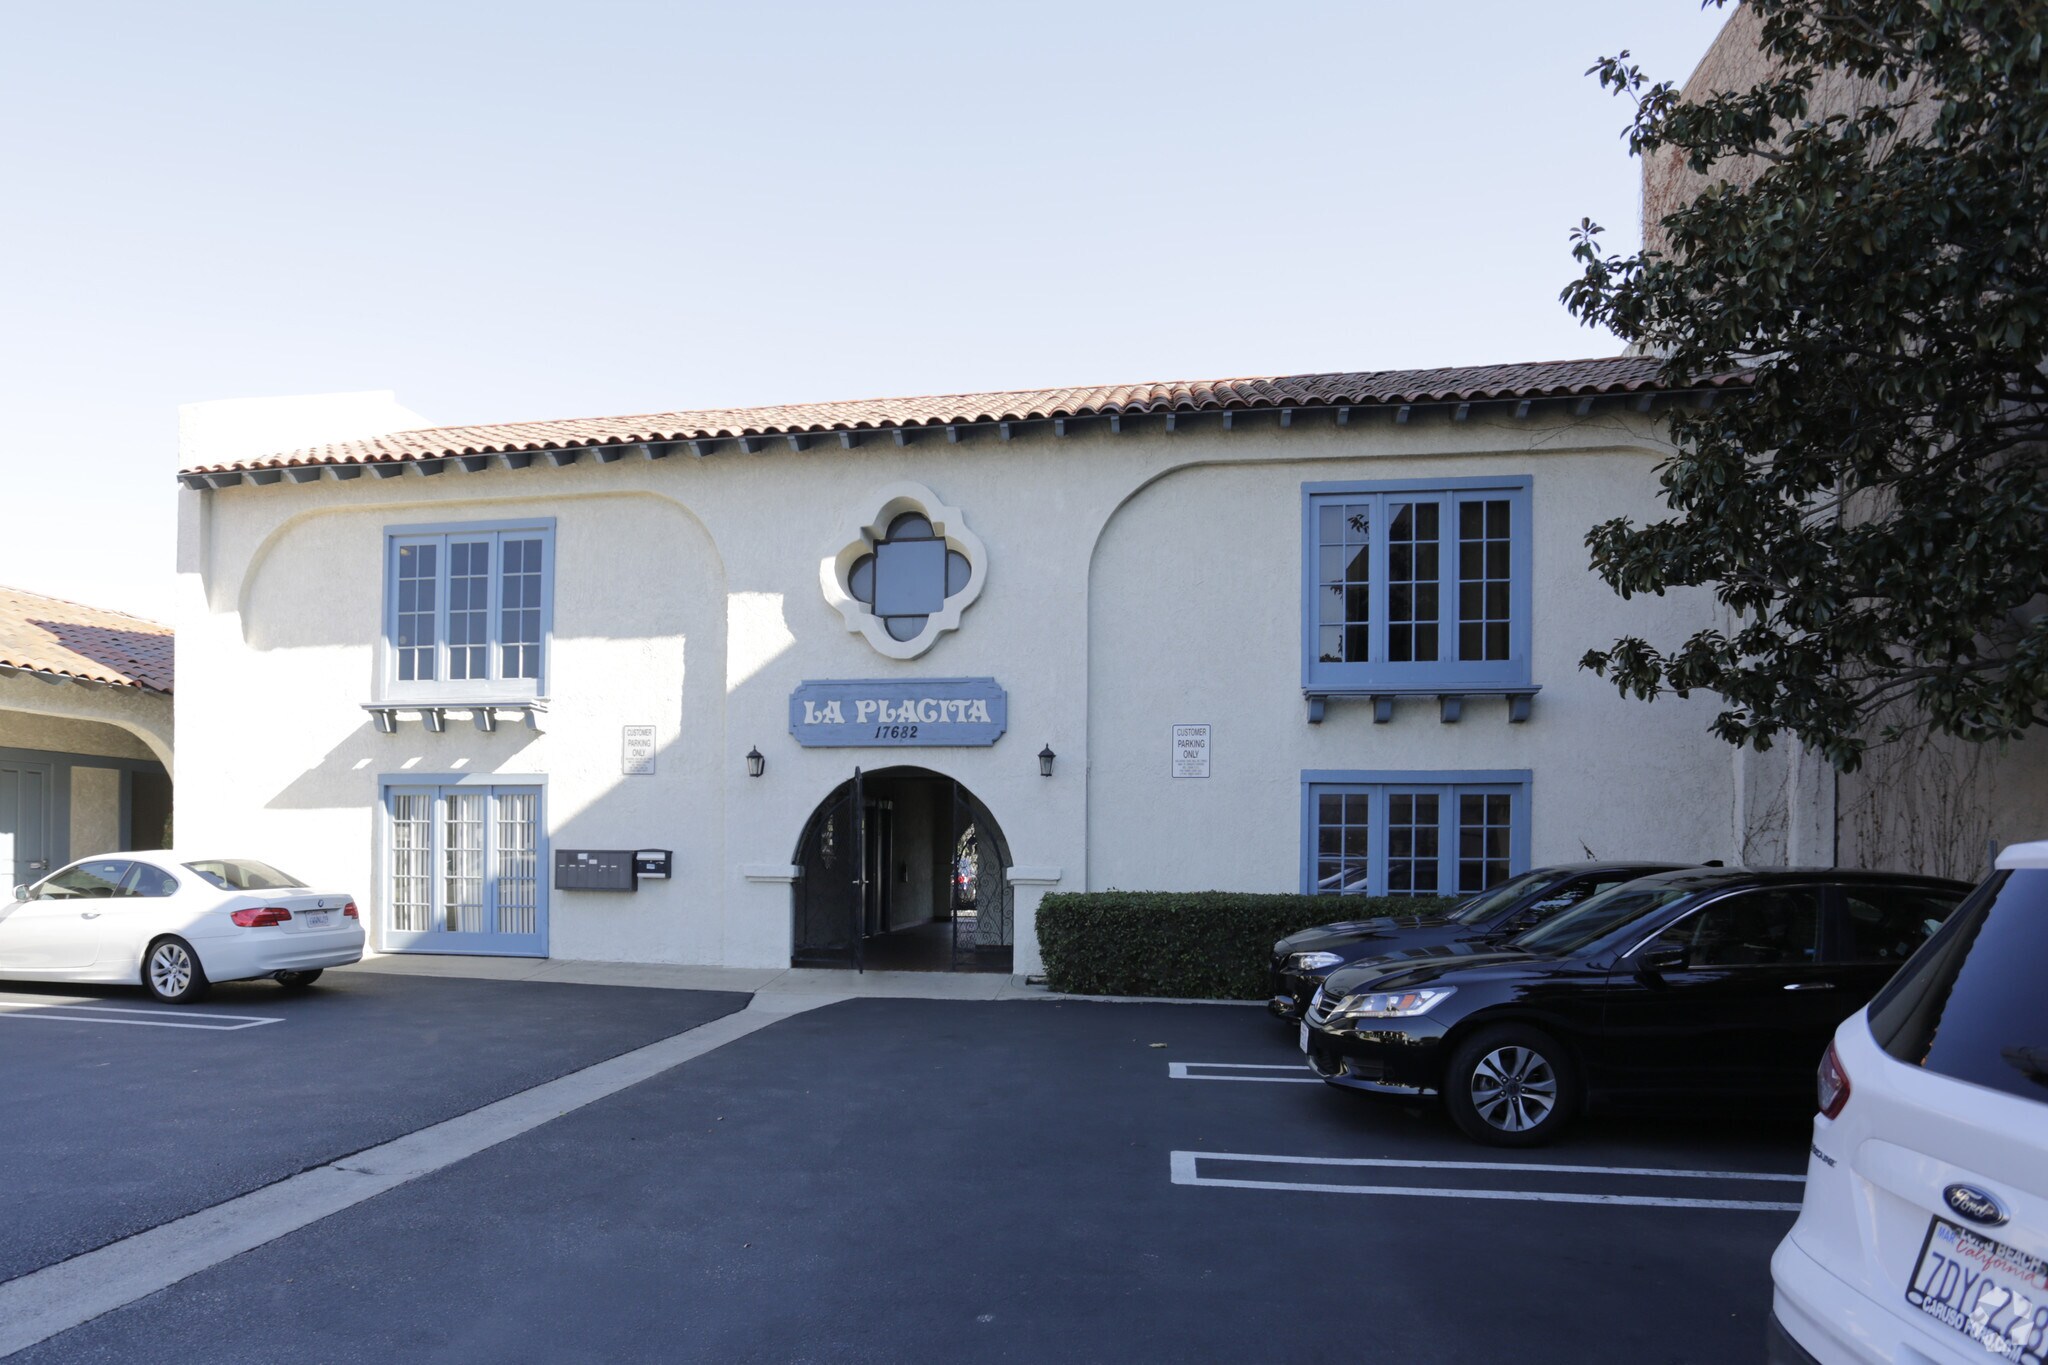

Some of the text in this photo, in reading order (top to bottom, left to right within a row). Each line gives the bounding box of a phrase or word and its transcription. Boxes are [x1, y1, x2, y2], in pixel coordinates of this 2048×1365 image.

[803, 698, 991, 724] LA PLACITA
[626, 728, 652, 737] CUSTOMER
[874, 725, 918, 739] 17682
[1176, 728, 1207, 737] CUSTOMER
[627, 738, 651, 747] PARKING
[1177, 739, 1205, 748] PARKING
[632, 748, 646, 757] ONLY
[1182, 749, 1200, 759] ONLY
[1950, 1187, 1996, 1217] Ford
[1937, 1225, 1956, 1244] MAR
[1956, 1238, 2036, 1281] California
[1921, 1295, 1964, 1329] CARUSO
